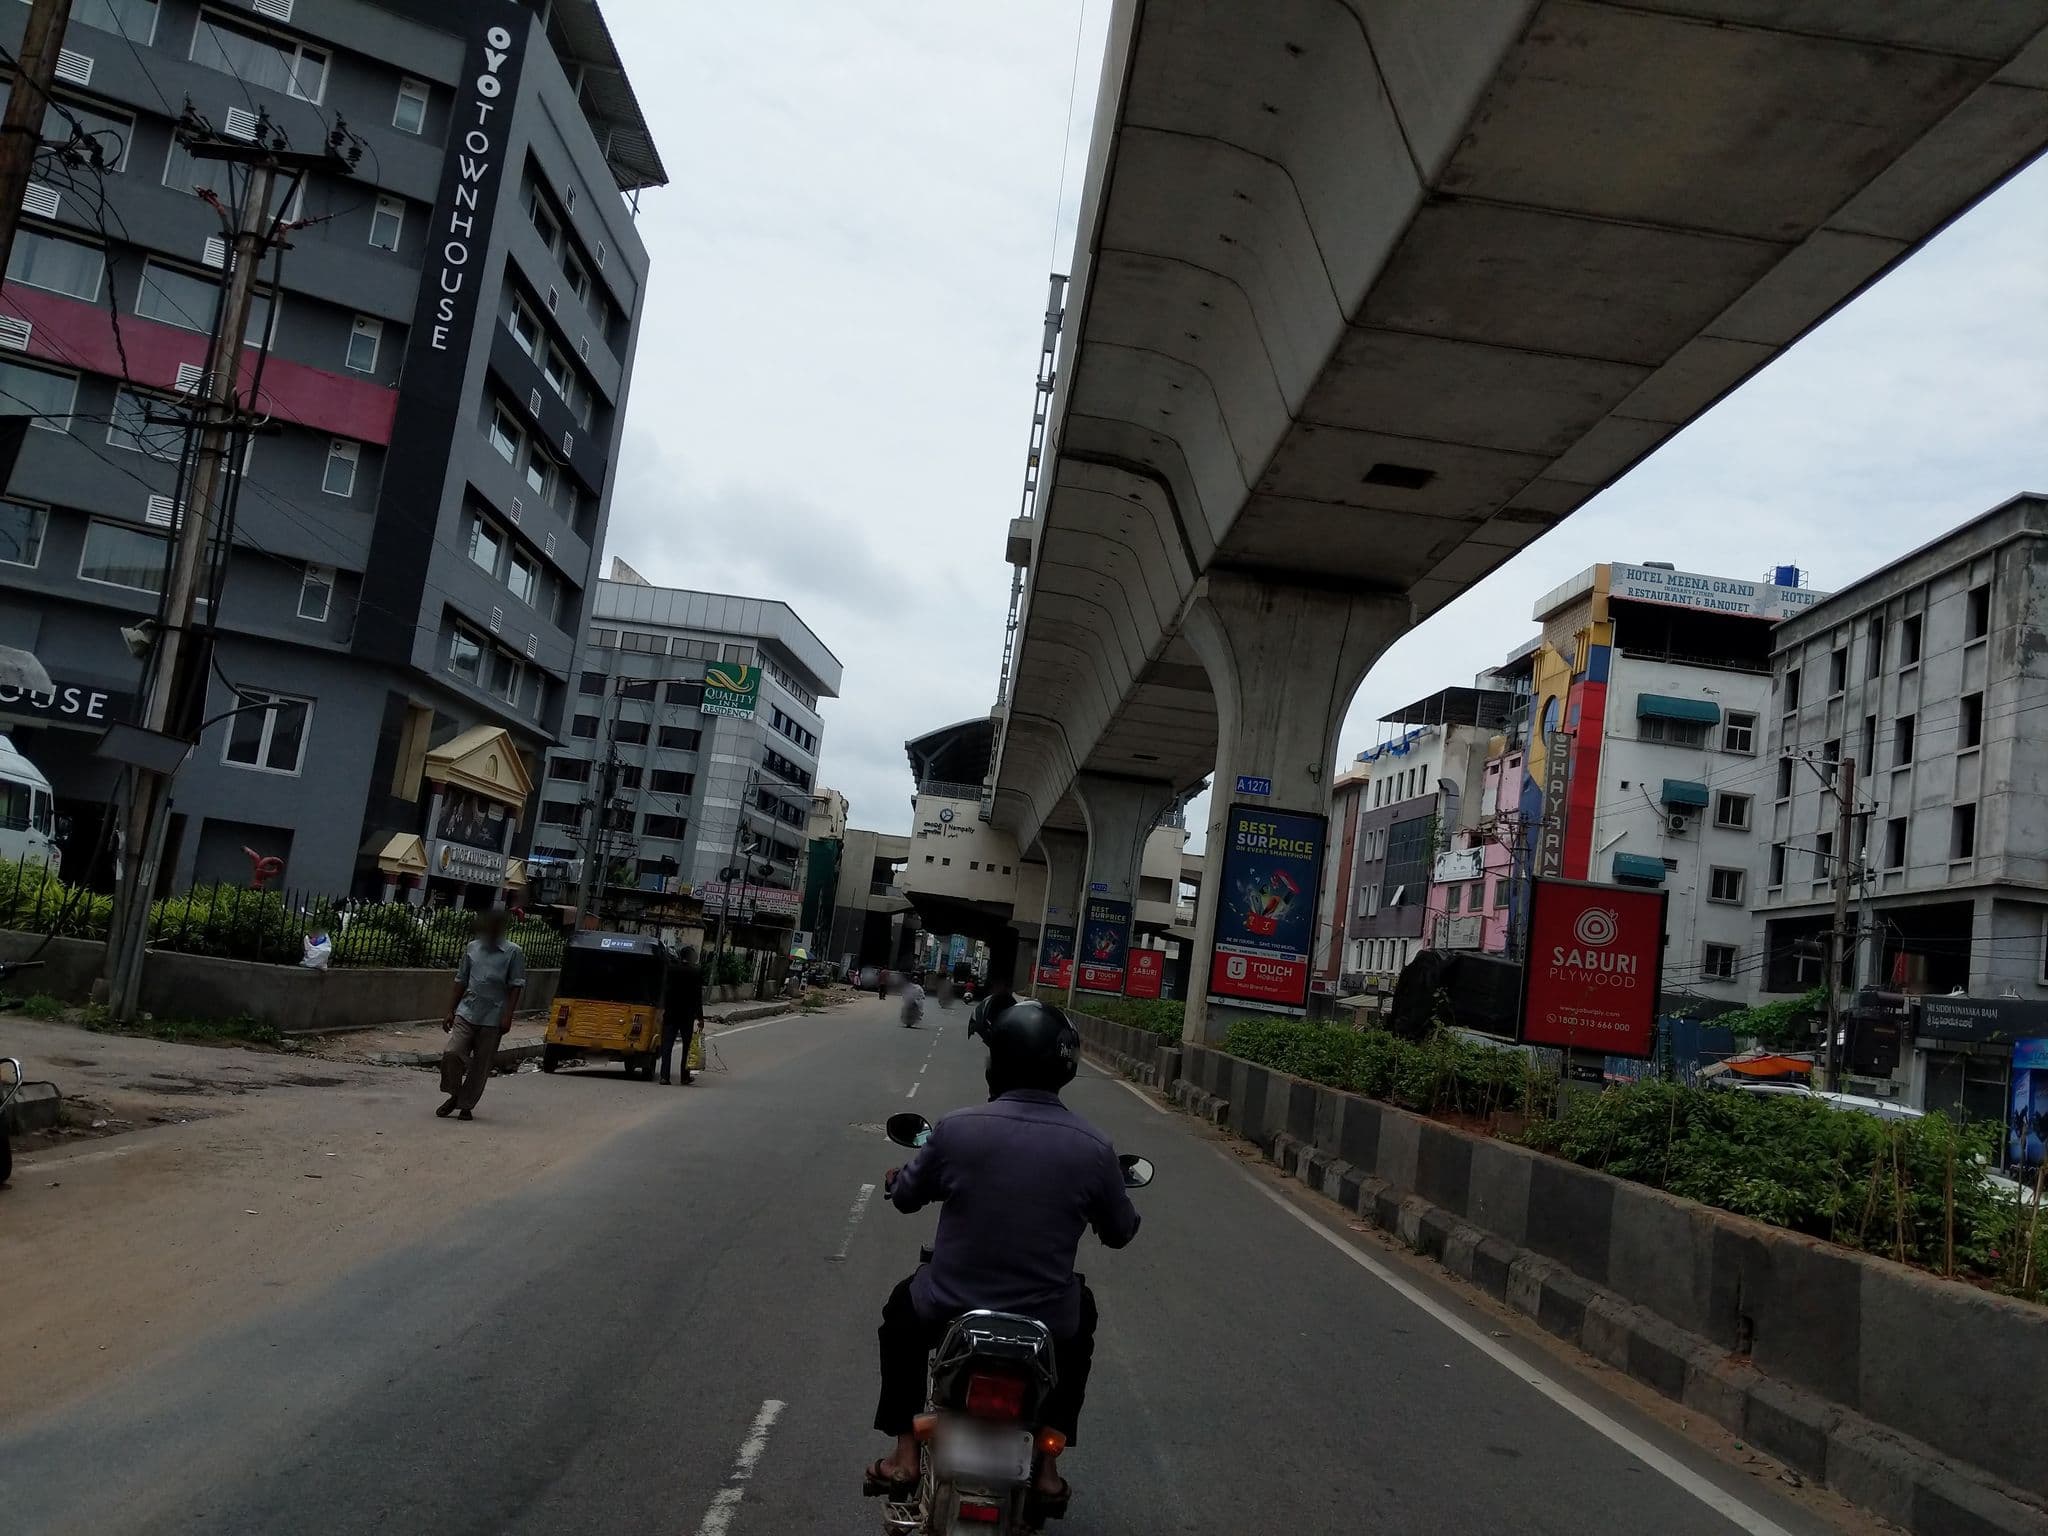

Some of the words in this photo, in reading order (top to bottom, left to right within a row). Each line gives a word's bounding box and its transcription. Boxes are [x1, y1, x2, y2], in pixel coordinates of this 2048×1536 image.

[476, 26, 512, 98] OYO
[431, 100, 494, 351] TOWNHOUSE
[1627, 568, 1662, 584] HOTEL
[1667, 574, 1709, 592] MEENA
[1714, 581, 1755, 598] GRAND
[1627, 587, 1694, 605] RESTAURANT
[1695, 597, 1701, 606] &
[1703, 598, 1750, 613] BANQUET
[1782, 590, 1817, 605] HOTEL
[705, 687, 755, 704] QUALITY
[703, 704, 752, 719] RESIDENCY
[719, 700, 738, 708] INN
[1237, 779, 1244, 790] A
[1248, 781, 1270, 794] 1271
[1239, 820, 1278, 836] BEST
[1236, 833, 1314, 854] SURPRICE
[1247, 847, 1267, 855] EVERY
[1270, 849, 1312, 861] SMARTPHONE
[1090, 911, 1127, 922] SURPRICE
[1091, 905, 1109, 915] BEST
[1551, 946, 1638, 975] SABURI
[1132, 967, 1158, 976] SABURI
[1251, 961, 1293, 977] TOUCH
[1256, 974, 1284, 983] MOBILES
[1550, 966, 1637, 989] PLYWOOD
[1558, 1015, 1579, 1026] 1800
[1580, 1018, 1595, 1028] 313
[1596, 1020, 1613, 1030] 666
[1614, 1022, 1631, 1033] 000
